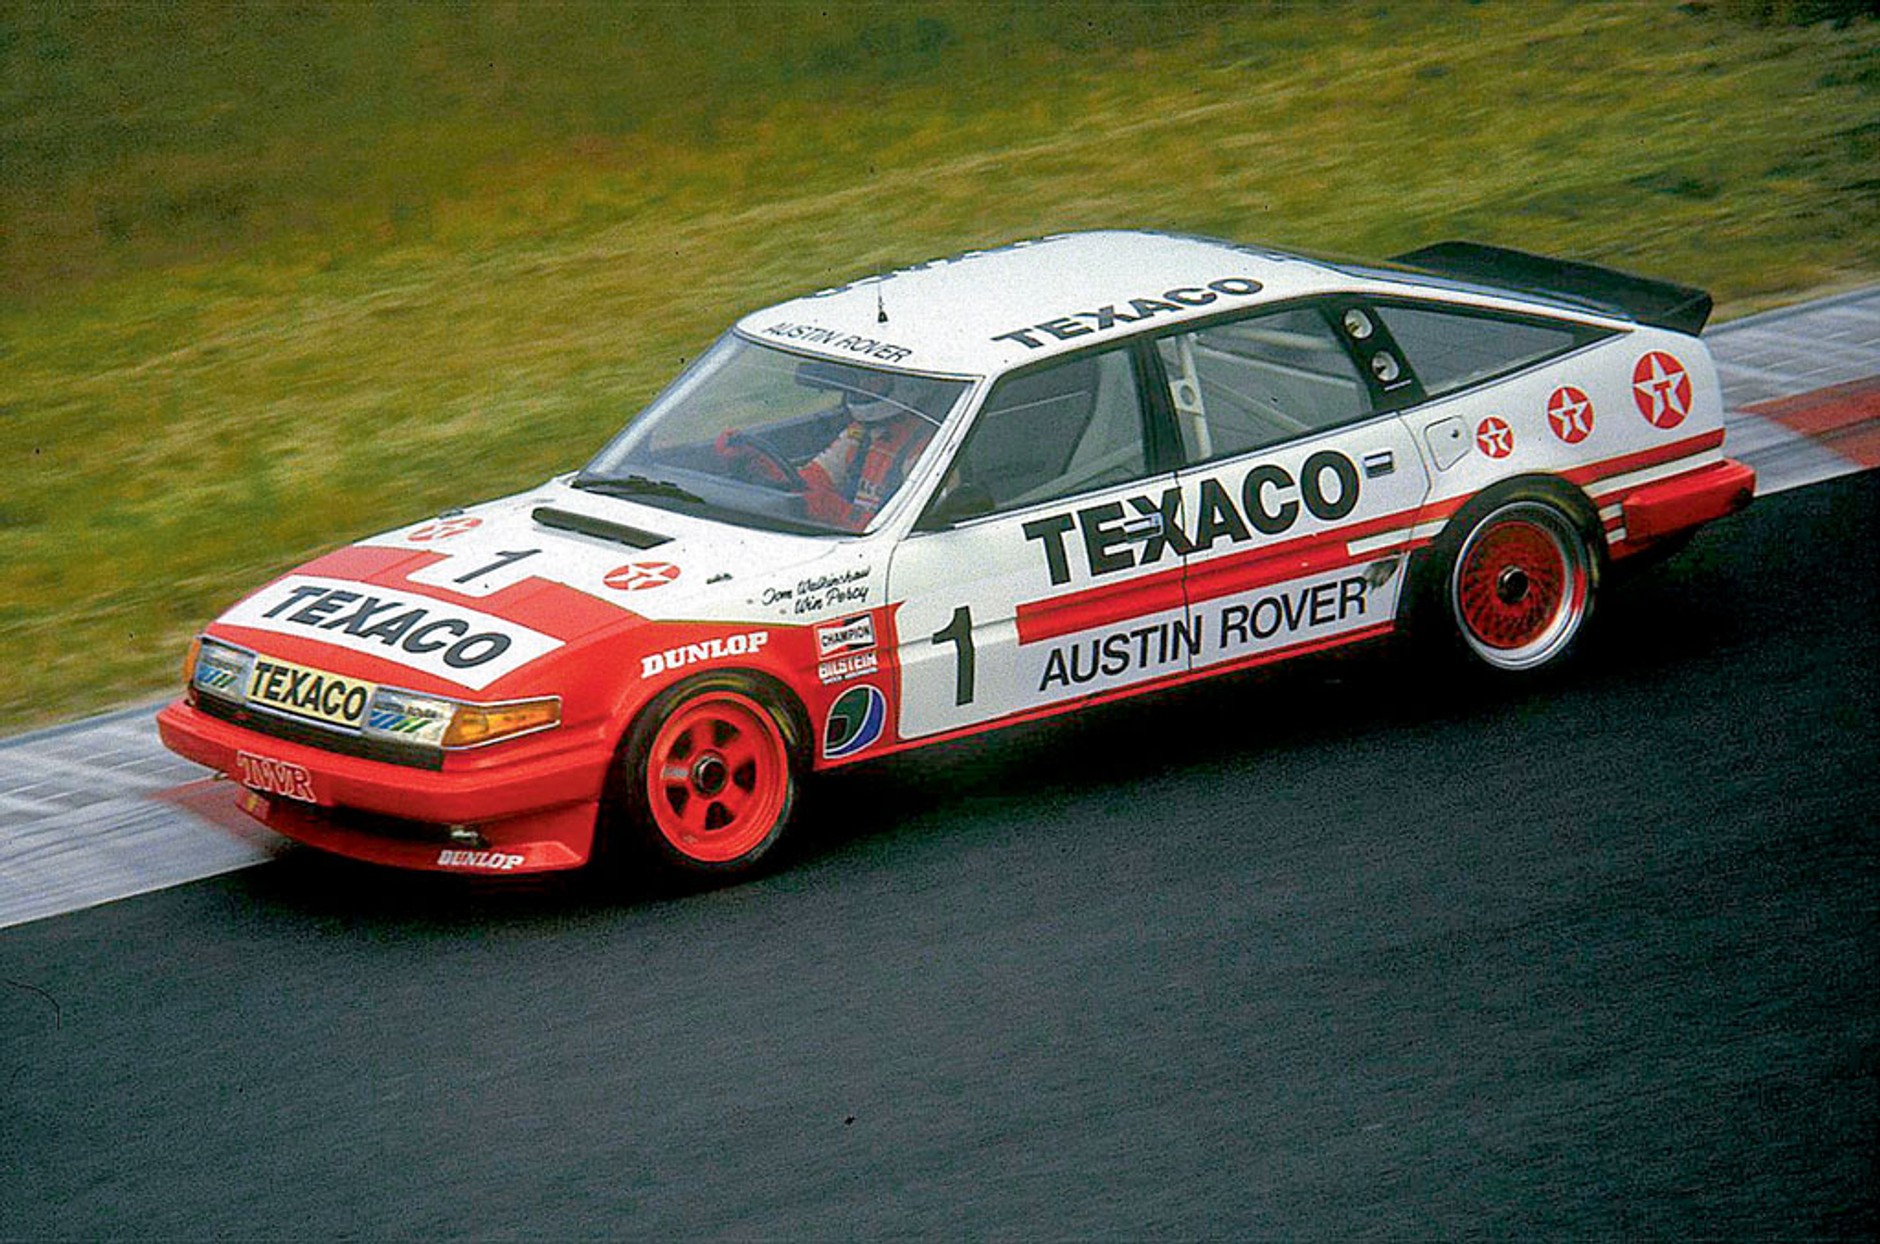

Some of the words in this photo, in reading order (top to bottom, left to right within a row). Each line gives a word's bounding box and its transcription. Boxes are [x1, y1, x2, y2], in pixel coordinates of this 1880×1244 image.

[990, 277, 1264, 349] TEXACO
[762, 322, 844, 345] AUSTIN
[835, 335, 912, 363] ROVER
[1021, 450, 1361, 587] TEXACO
[453, 549, 542, 584] 1
[261, 585, 512, 669] TEXACO
[794, 595, 823, 614] Win
[641, 631, 769, 679] DUNLOP
[821, 625, 871, 647] CHAMPION
[932, 606, 975, 707] 1
[1038, 615, 1202, 692] AUSTIN
[1218, 575, 1368, 648] ROVER
[251, 662, 368, 721] TEXACO
[237, 750, 317, 803] TWR
[437, 850, 524, 870] DUNLOP
